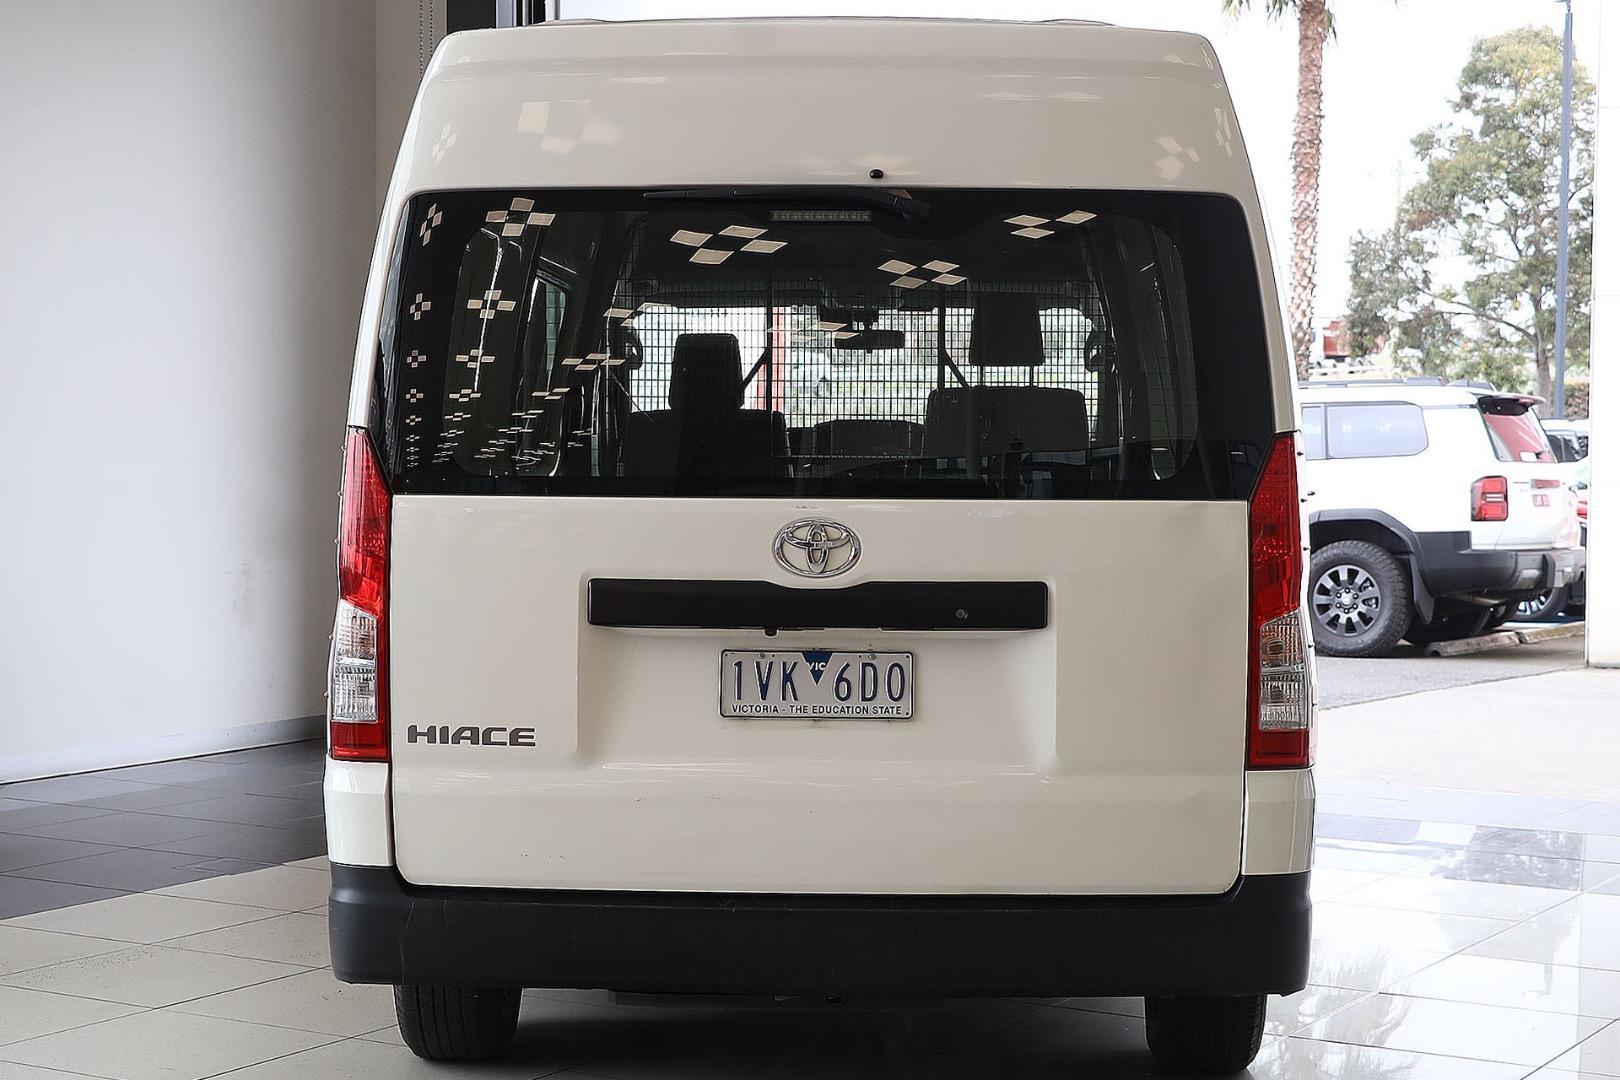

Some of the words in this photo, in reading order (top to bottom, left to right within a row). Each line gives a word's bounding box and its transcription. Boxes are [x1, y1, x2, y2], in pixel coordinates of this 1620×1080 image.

[733, 660, 798, 701] 1VK
[732, 704, 779, 714] VICTORIA
[789, 704, 808, 714] THE
[812, 705, 869, 714] EDUCATION
[872, 705, 902, 715] STATE
[407, 724, 536, 747] HIACE
